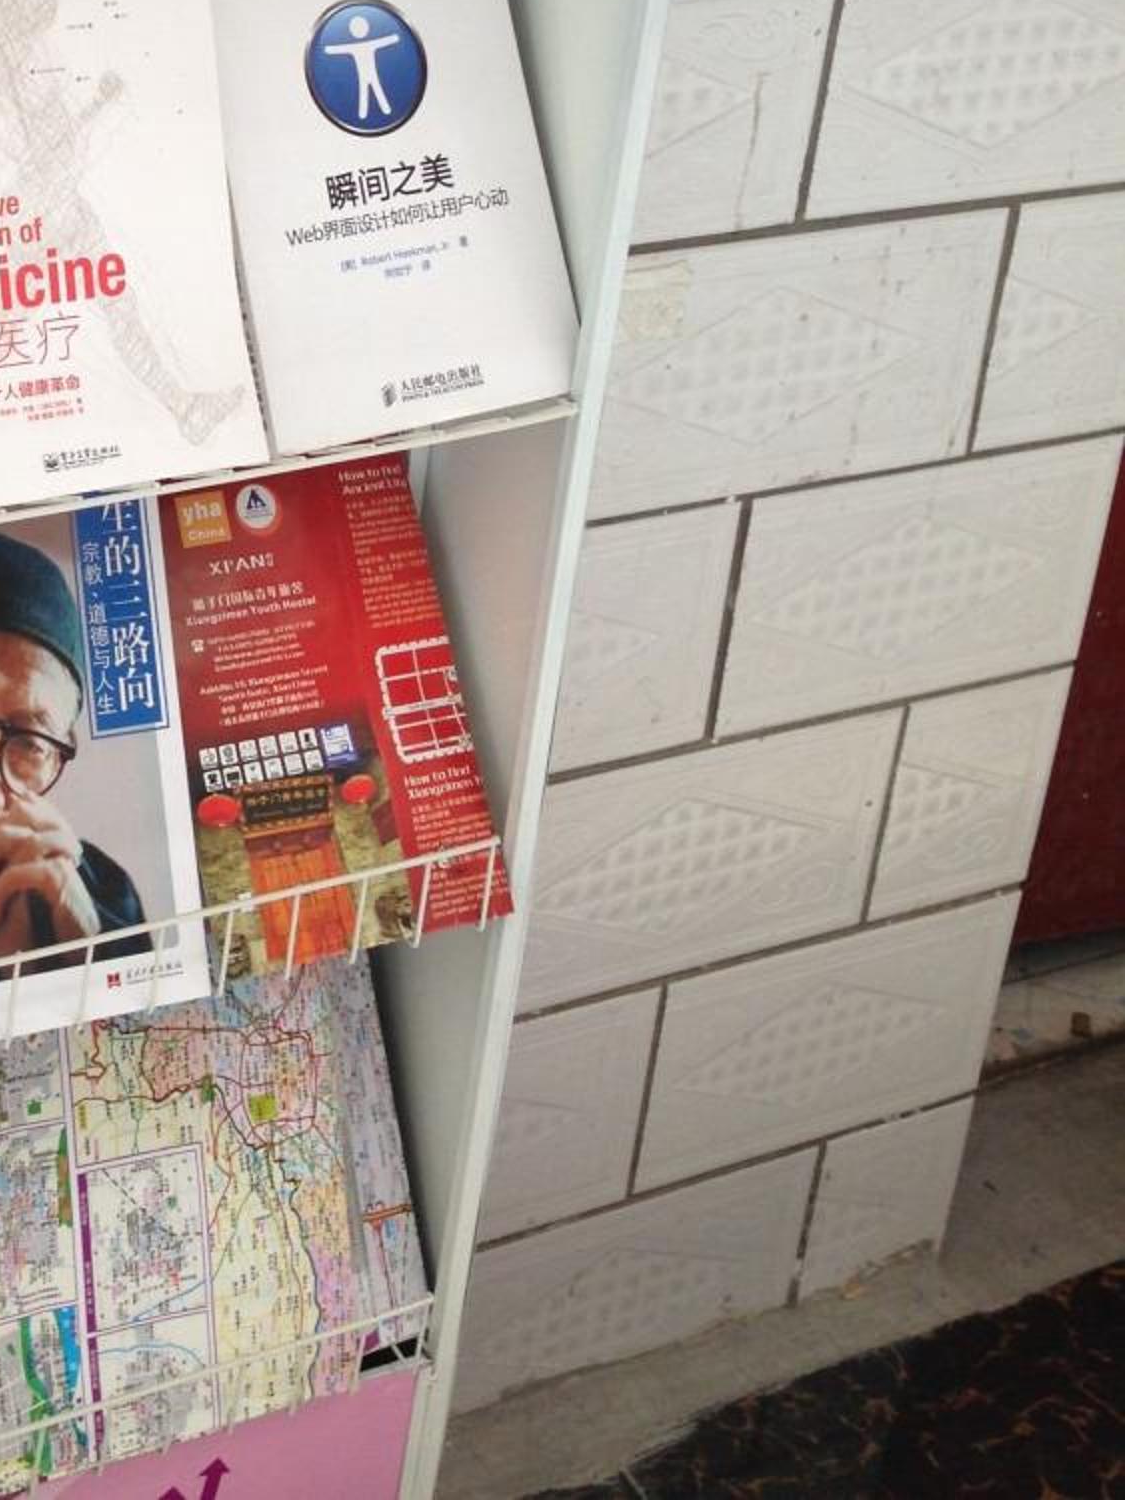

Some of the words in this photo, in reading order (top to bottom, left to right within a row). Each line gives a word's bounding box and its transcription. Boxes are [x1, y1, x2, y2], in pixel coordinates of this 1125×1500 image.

[325, 155, 455, 210] 瞬间之美
[20, 216, 44, 242] of
[182, 501, 223, 525] yha
[81, 541, 118, 716] 宗教、道德与人生
